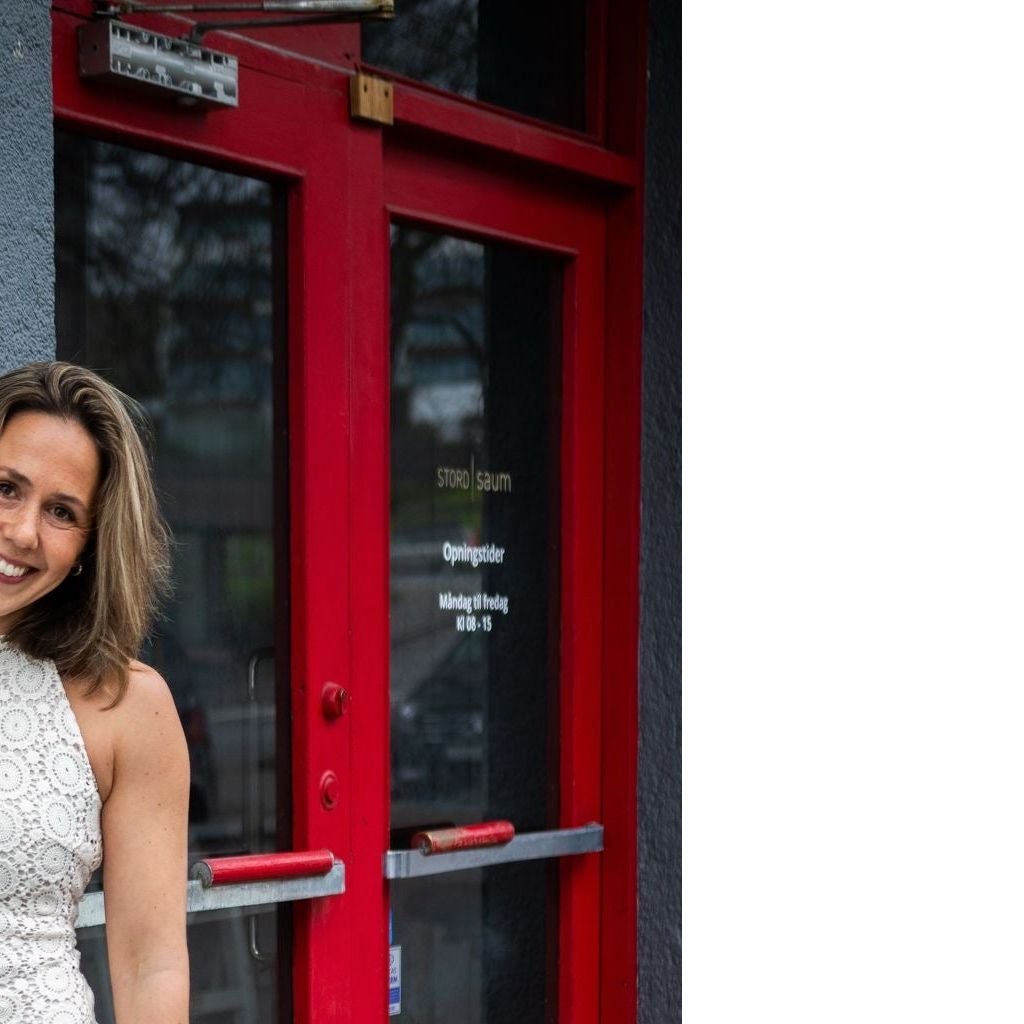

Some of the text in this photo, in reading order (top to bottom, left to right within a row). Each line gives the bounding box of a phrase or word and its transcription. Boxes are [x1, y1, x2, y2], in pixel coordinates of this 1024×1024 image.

[437, 468, 512, 493] STORD saum
[443, 541, 505, 568] Opningstider
[439, 591, 509, 614] Måndag til fredag
[466, 616, 476, 632] 08
[482, 616, 492, 632] 15
